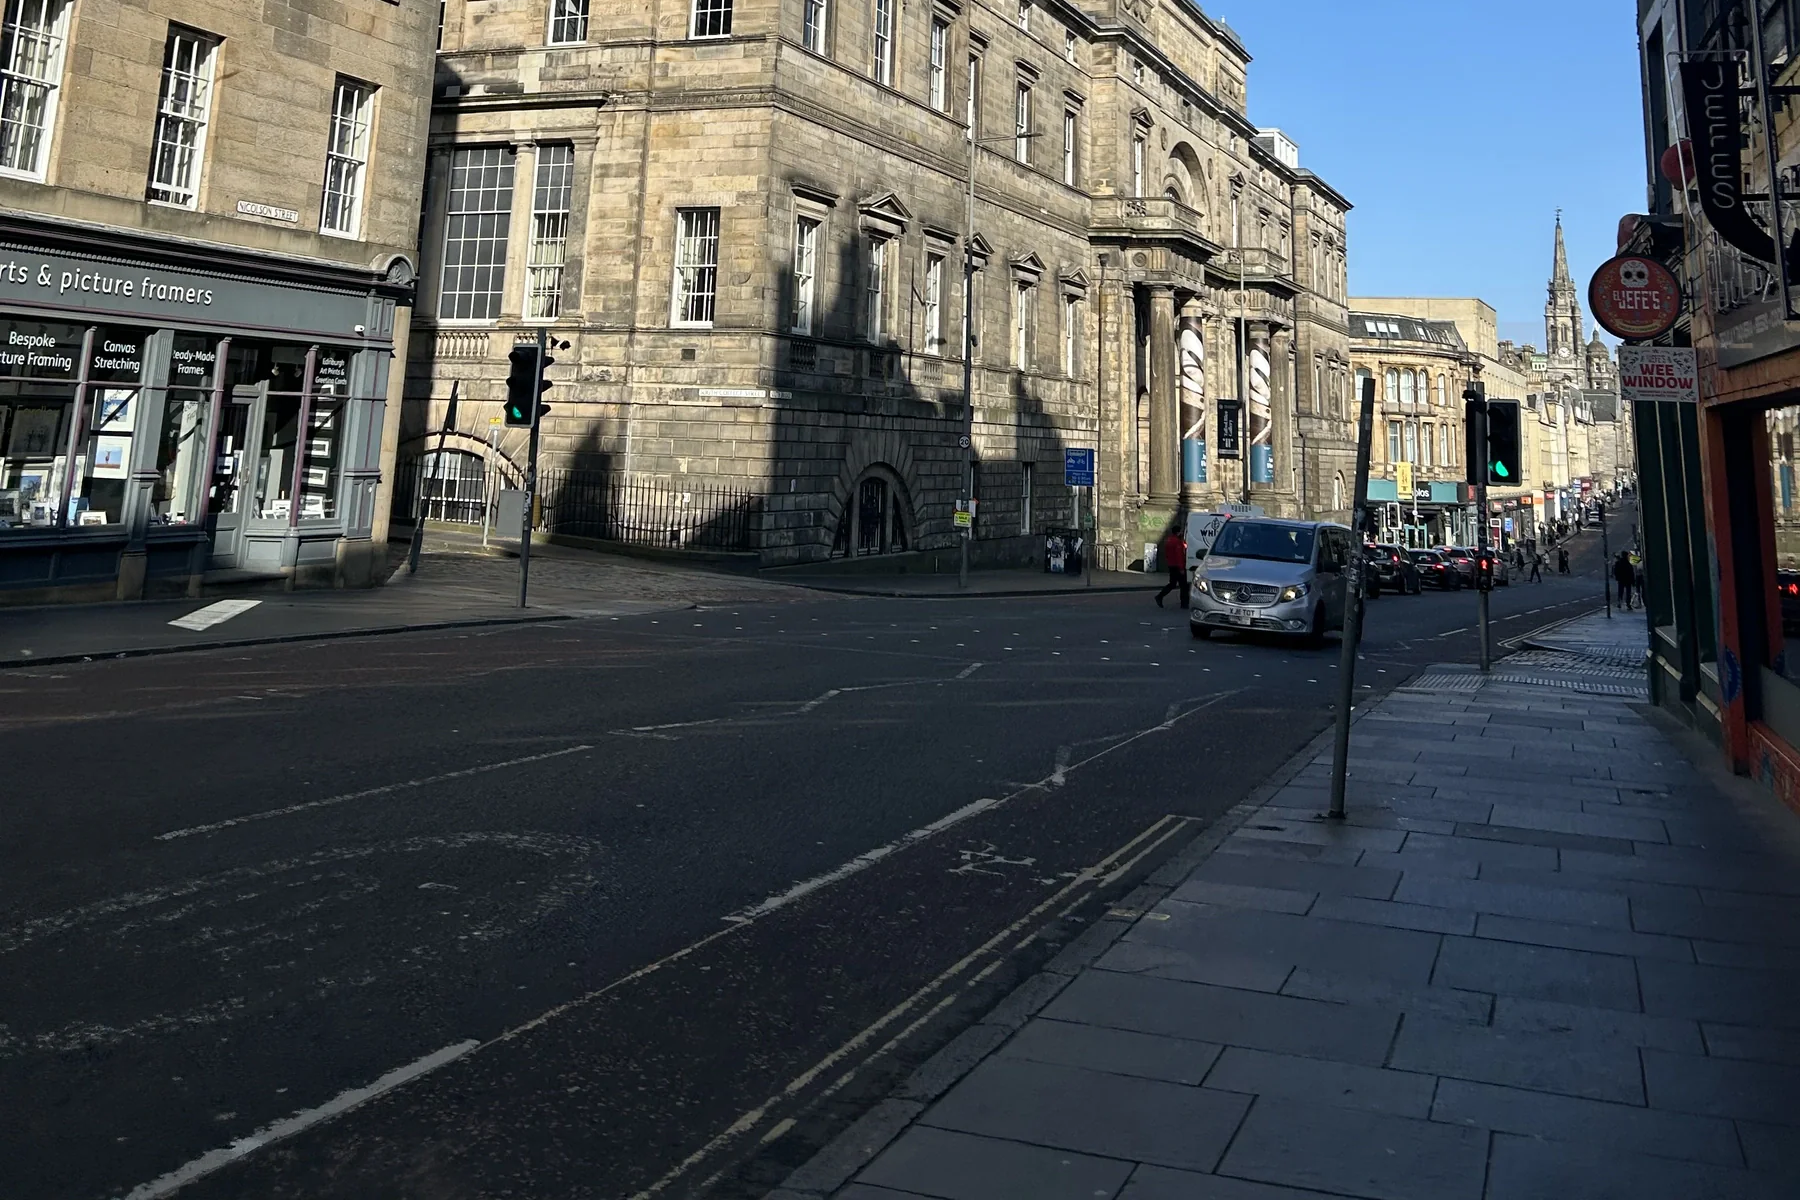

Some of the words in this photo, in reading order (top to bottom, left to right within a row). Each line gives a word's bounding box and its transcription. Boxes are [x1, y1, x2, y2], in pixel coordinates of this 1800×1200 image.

[239, 202, 272, 216] NICOLSON
[275, 209, 297, 221] STREET
[37, 264, 51, 286] &
[60, 268, 133, 296] picture
[141, 277, 213, 304] framers
[1619, 291, 1661, 310] JEFE'S
[9, 331, 56, 349] Bespoke
[104, 340, 136, 354] Canvas
[0, 351, 25, 365] ture
[27, 353, 72, 371] Framing
[94, 356, 140, 373] Stretching
[322, 357, 345, 367] Edinburgh
[177, 363, 205, 375] Frames
[319, 367, 327, 375] Art
[327, 368, 340, 376] Prints
[1639, 363, 1674, 376] WEE
[314, 376, 334, 385] Greeting
[334, 377, 348, 386] Cards
[1622, 375, 1693, 389] WINDOW
[960, 438, 969, 446] 20
